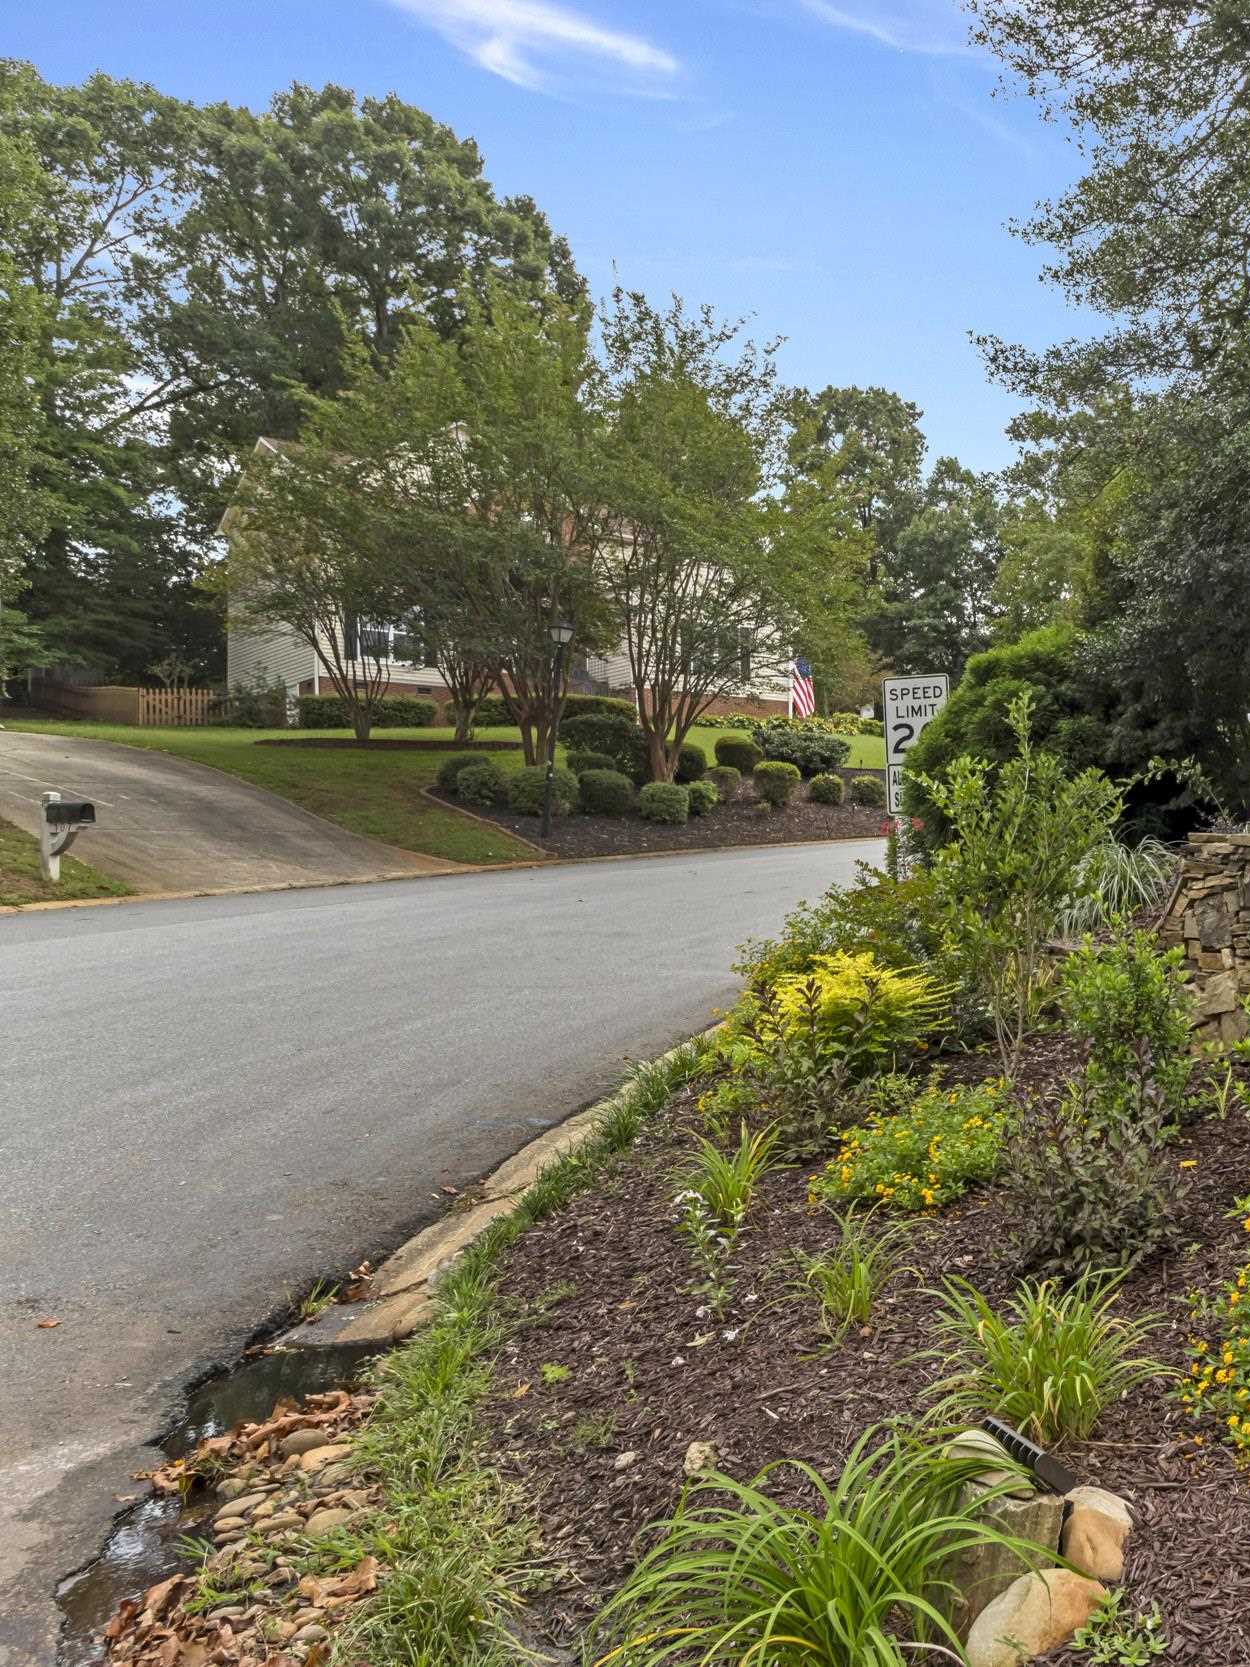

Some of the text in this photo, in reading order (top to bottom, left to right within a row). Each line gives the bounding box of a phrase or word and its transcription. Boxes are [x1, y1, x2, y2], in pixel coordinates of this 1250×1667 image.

[889, 686, 943, 701] SPEED
[896, 704, 937, 718] LIMIT
[892, 721, 932, 754] 2
